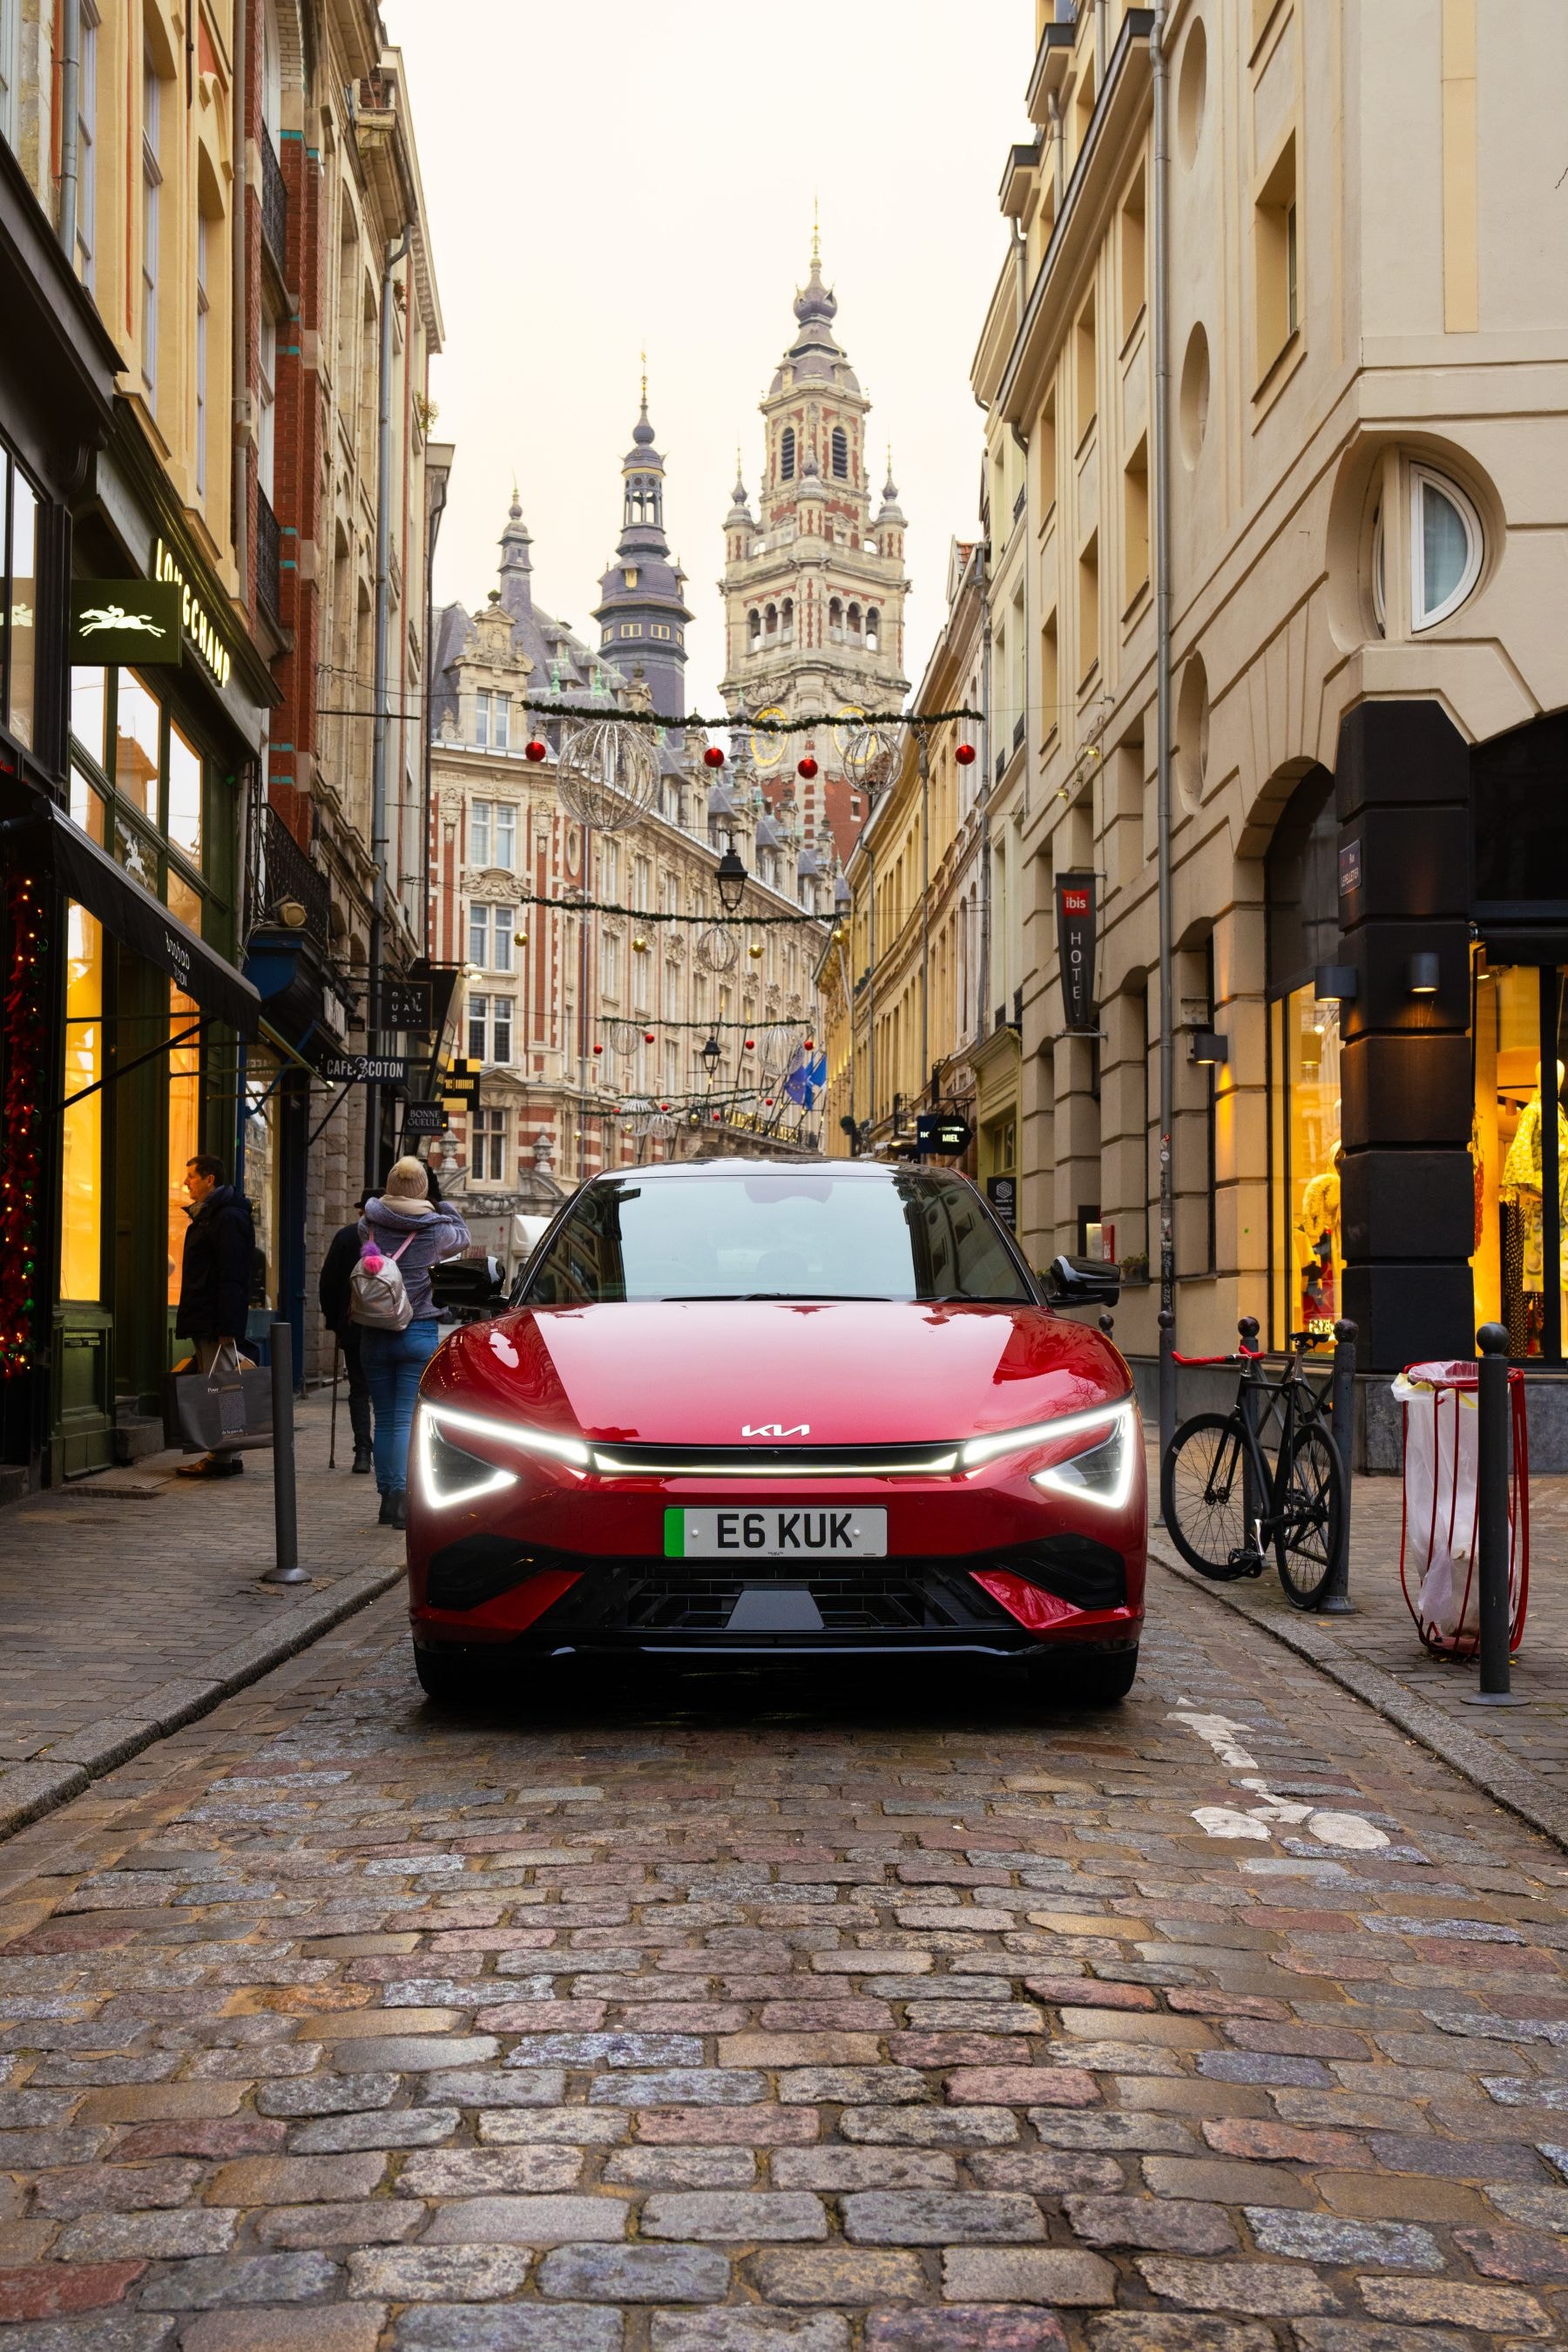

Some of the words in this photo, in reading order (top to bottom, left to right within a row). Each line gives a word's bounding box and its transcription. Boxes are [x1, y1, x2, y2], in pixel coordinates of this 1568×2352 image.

[1065, 896, 1087, 909] ibis
[368, 1061, 403, 1078] COTON
[409, 1109, 441, 1119] BONNE
[407, 1118, 443, 1127] GUEULE
[942, 1133, 960, 1143] MIEL
[741, 1424, 810, 1437] KIA
[717, 1513, 766, 1549] E6
[778, 1513, 853, 1549] KUK
